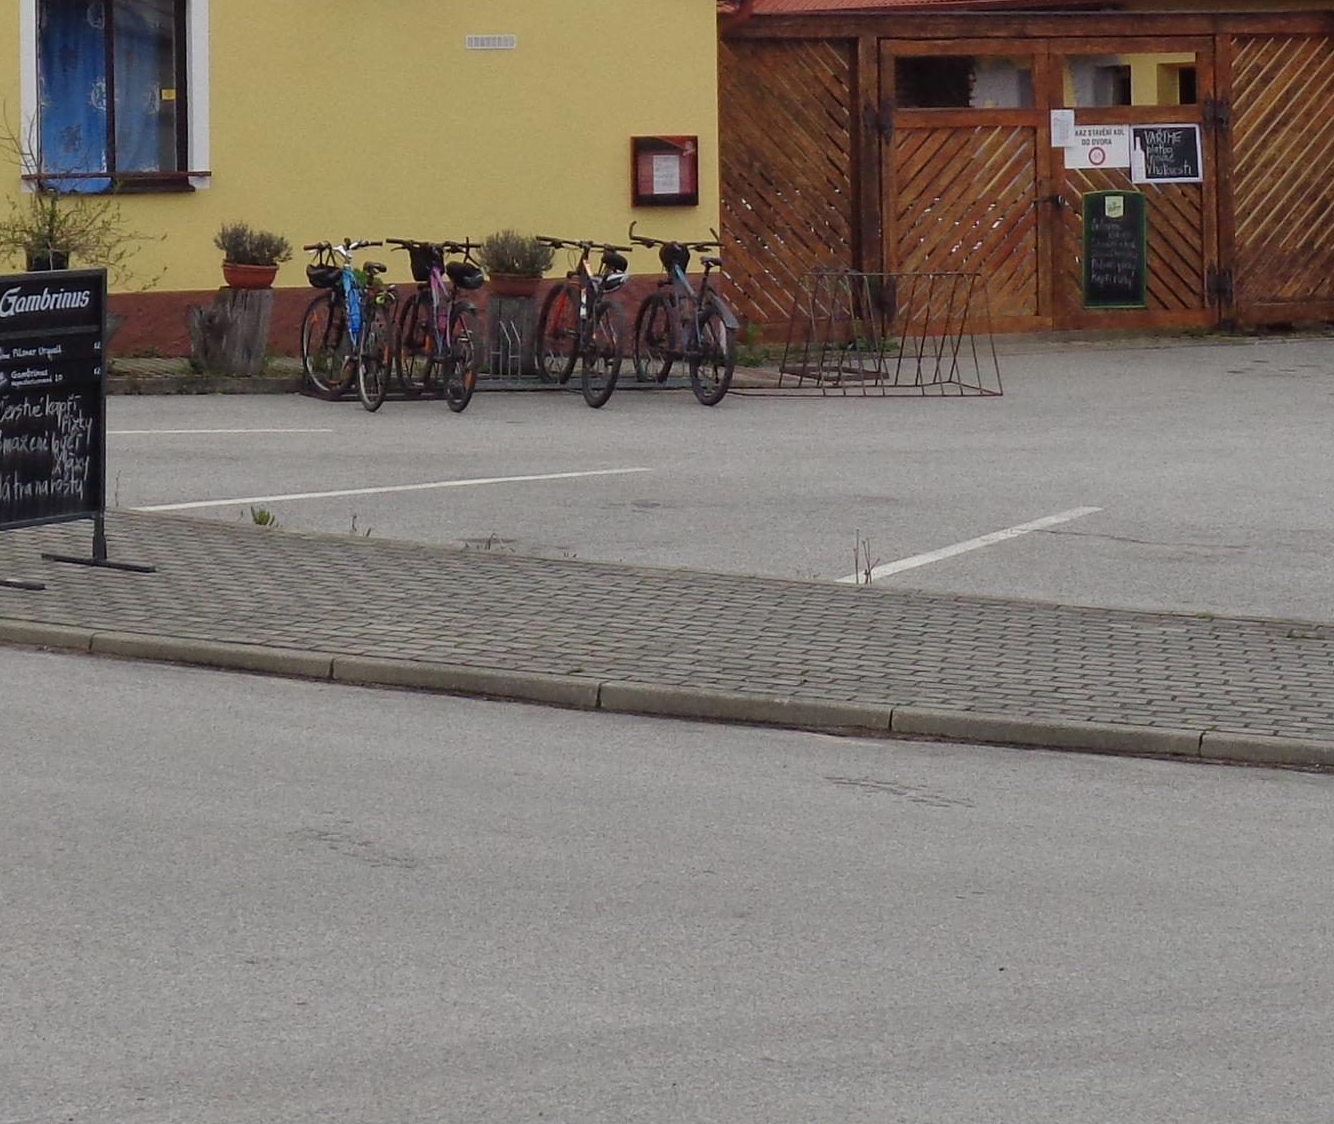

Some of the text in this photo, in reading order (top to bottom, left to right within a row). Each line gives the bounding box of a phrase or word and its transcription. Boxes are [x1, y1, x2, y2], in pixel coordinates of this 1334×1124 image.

[1081, 138, 1113, 146] DO DVORA
[10, 367, 48, 380] Gambrinus
